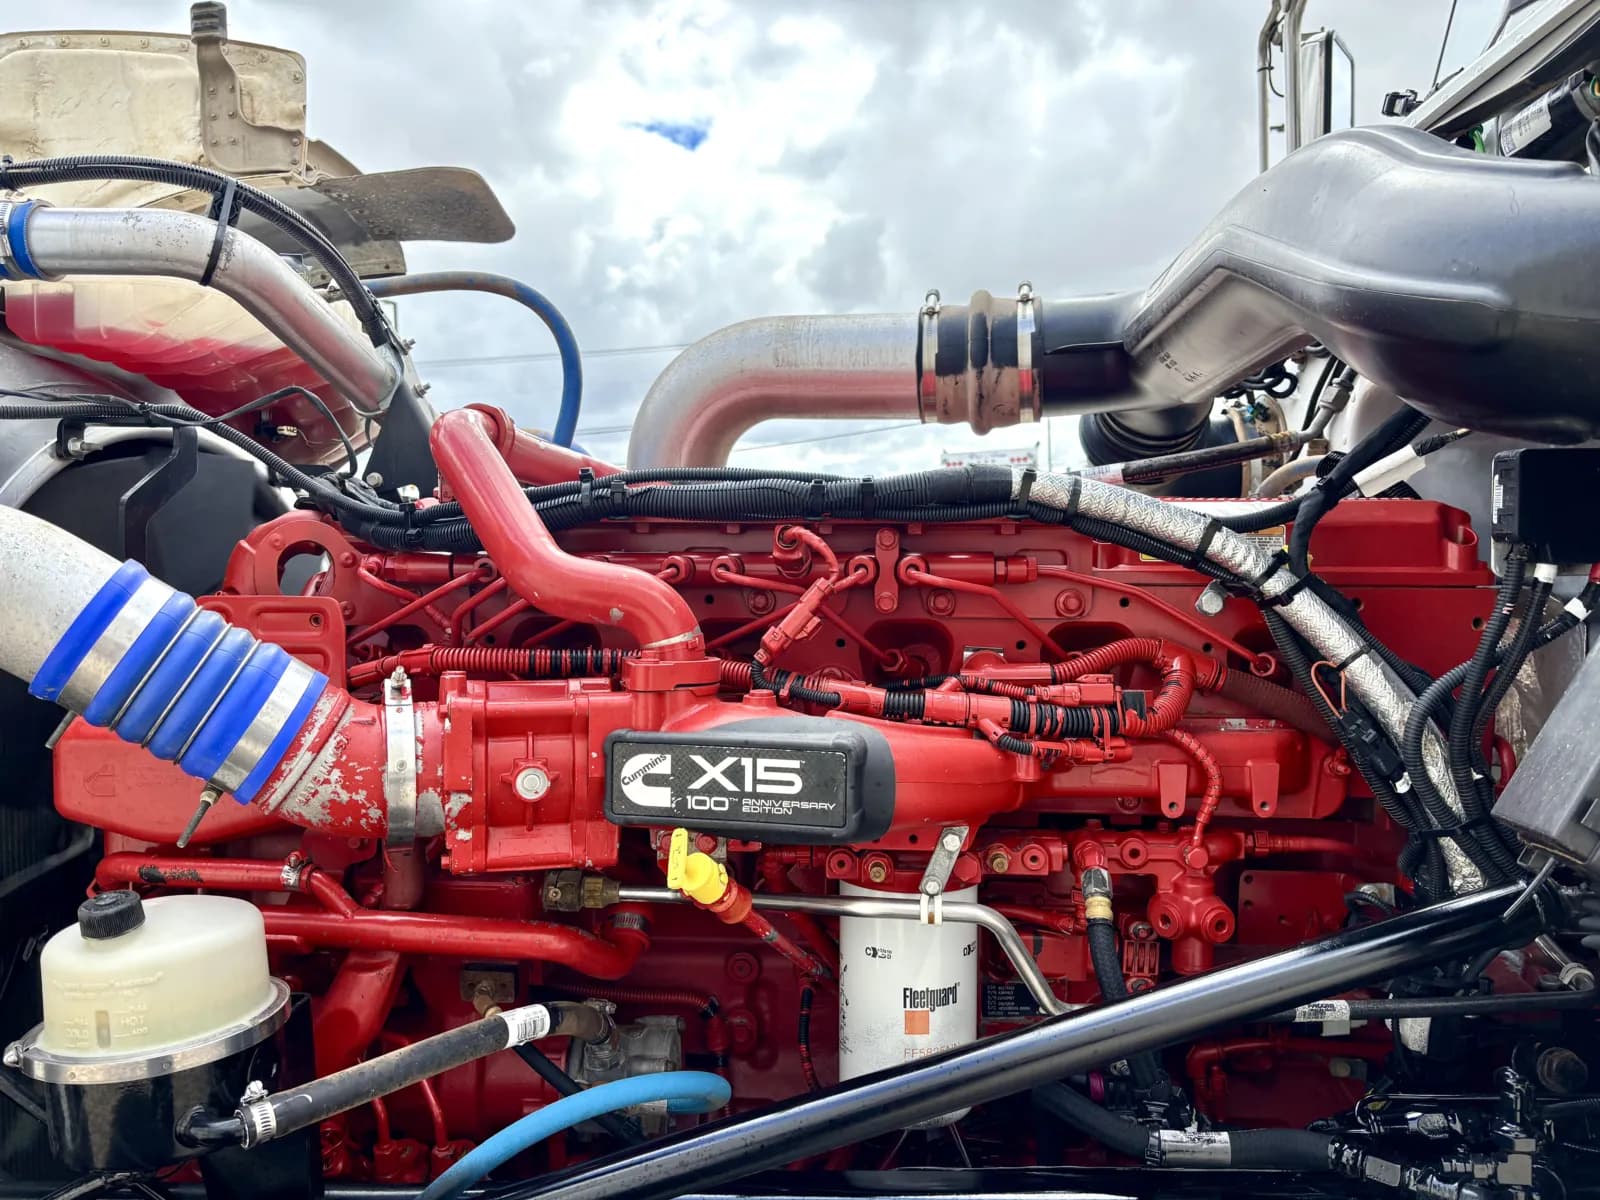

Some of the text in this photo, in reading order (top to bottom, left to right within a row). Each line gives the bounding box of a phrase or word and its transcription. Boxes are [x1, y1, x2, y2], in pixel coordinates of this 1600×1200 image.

[621, 754, 667, 786] Cummins
[687, 755, 803, 795] X15
[742, 798, 836, 811] ANNIVERSARY
[742, 806, 793, 815] EDITION
[903, 982, 958, 1012] Fleetguard
